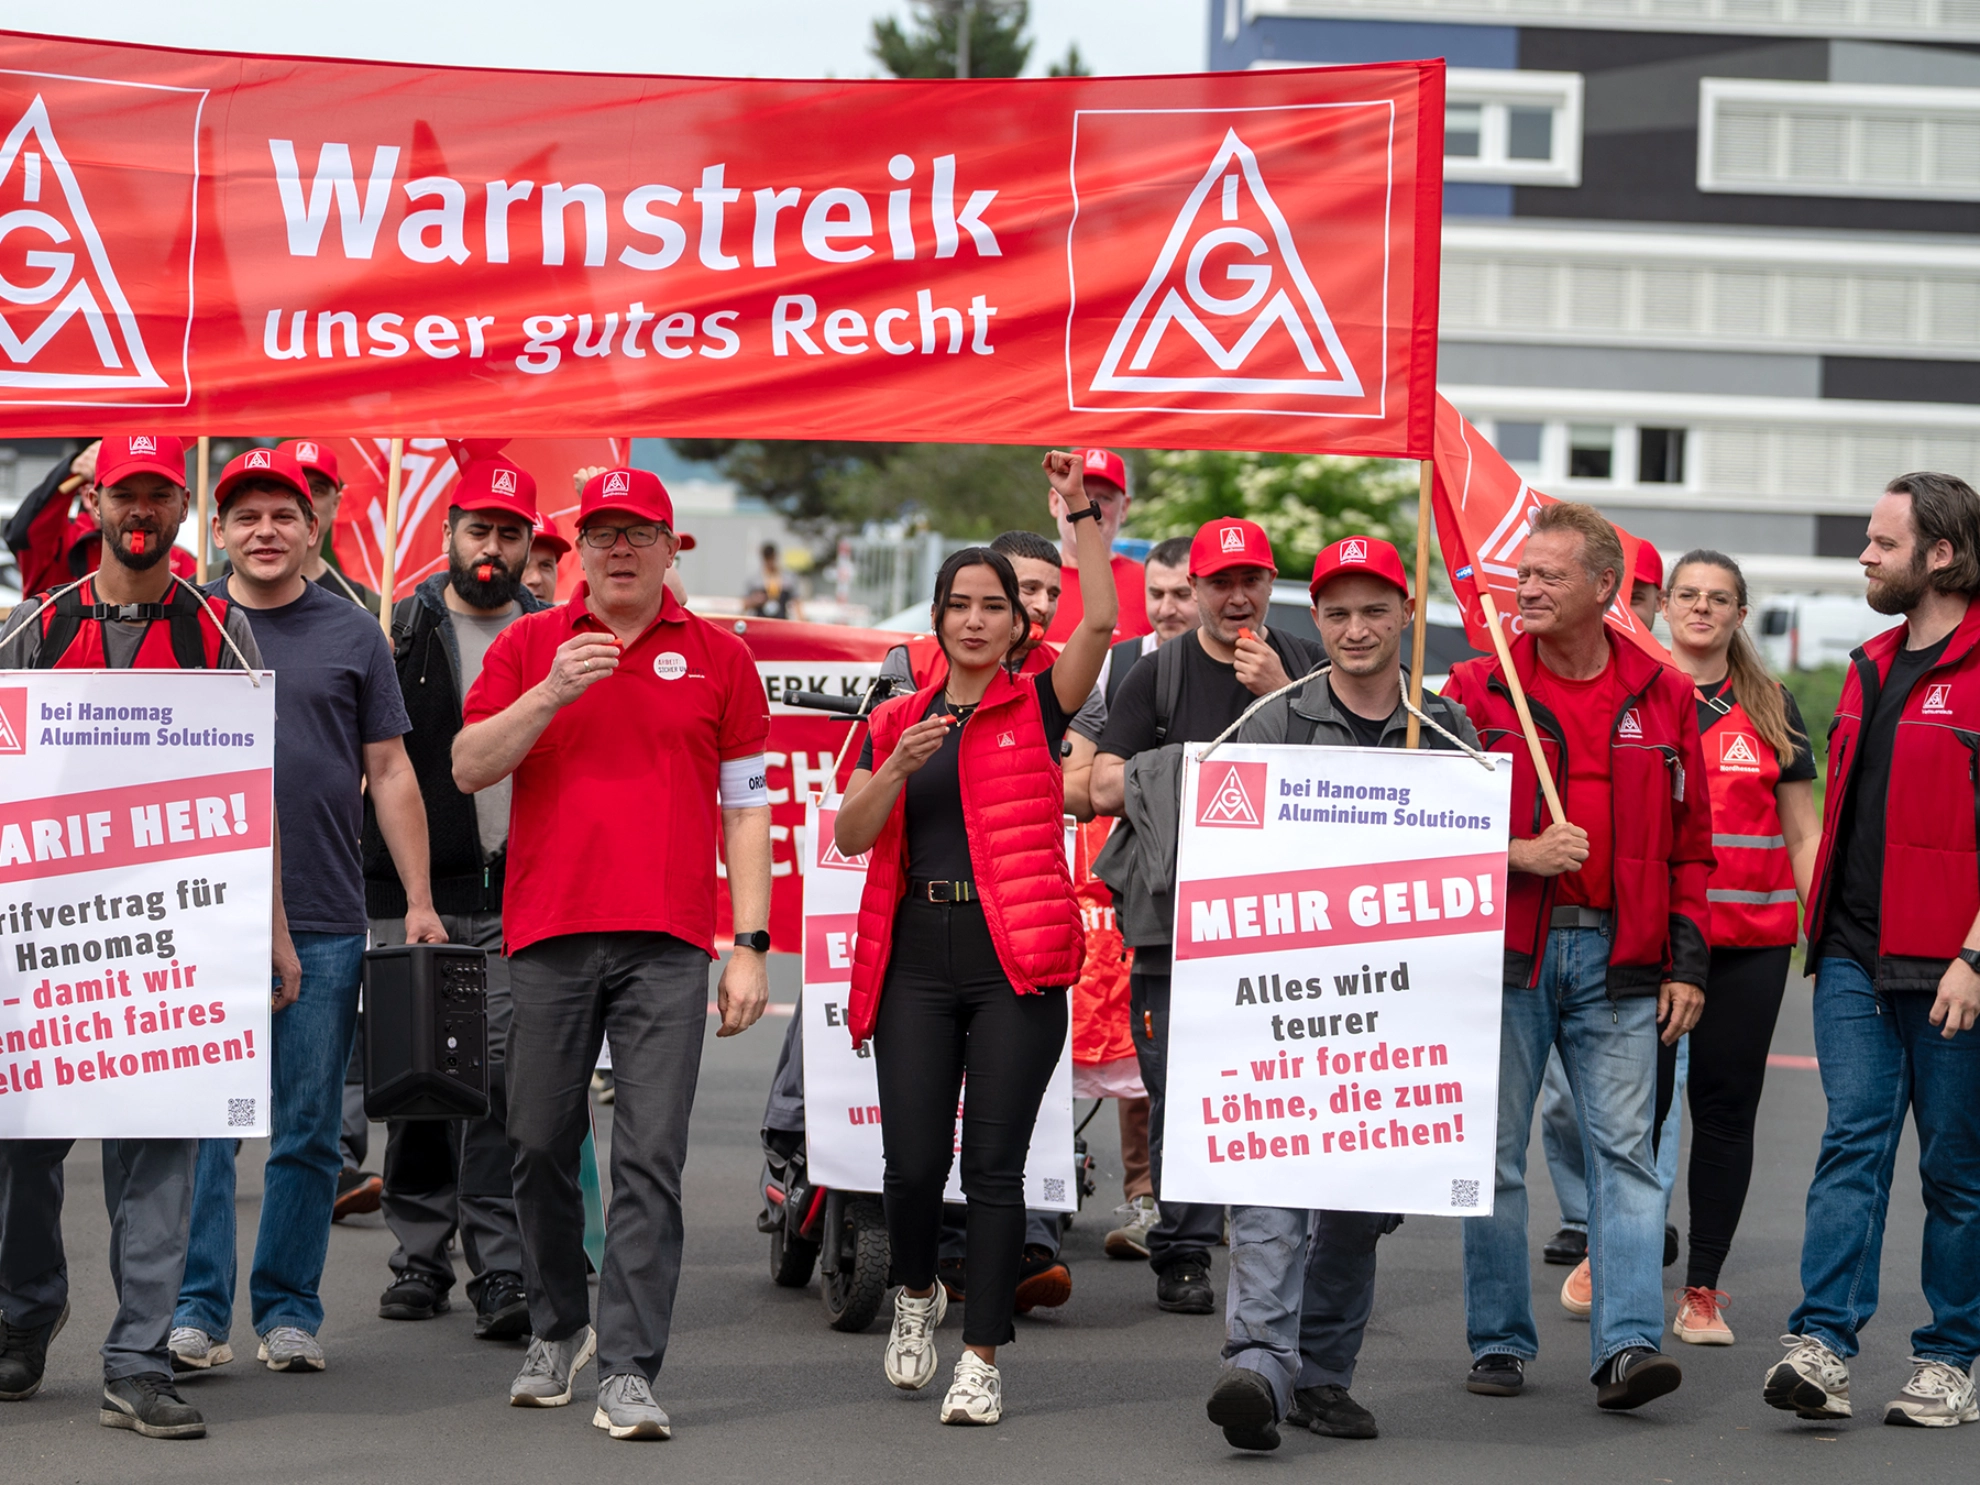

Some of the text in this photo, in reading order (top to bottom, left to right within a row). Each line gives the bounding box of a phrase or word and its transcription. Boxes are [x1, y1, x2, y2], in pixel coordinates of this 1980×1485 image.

[268, 138, 1003, 271] Warnstreik
[263, 289, 998, 374] unser gutes Recht
[41, 702, 173, 726] bei Hanomag
[40, 727, 255, 747] Aluminium Solutions
[1280, 778, 1411, 806] bei Hanomag
[130, 792, 251, 849] HER!
[1278, 803, 1491, 830] Aluminium Solutions
[176, 878, 227, 910] für
[1190, 873, 1495, 943] MEHR GELD!
[15, 926, 176, 973] Hanomag
[33, 968, 132, 1010] damit
[142, 959, 197, 993] wir
[1235, 961, 1410, 1006] Alles wird
[123, 1000, 226, 1036] faires
[1271, 1010, 1379, 1042] teurer
[54, 1029, 256, 1087] bekommen!
[1250, 1049, 1304, 1082] wir
[1316, 1041, 1448, 1076] fordern
[1202, 1081, 1463, 1125] Löhne, die zum
[1207, 1113, 1465, 1163] Leben reichen!
